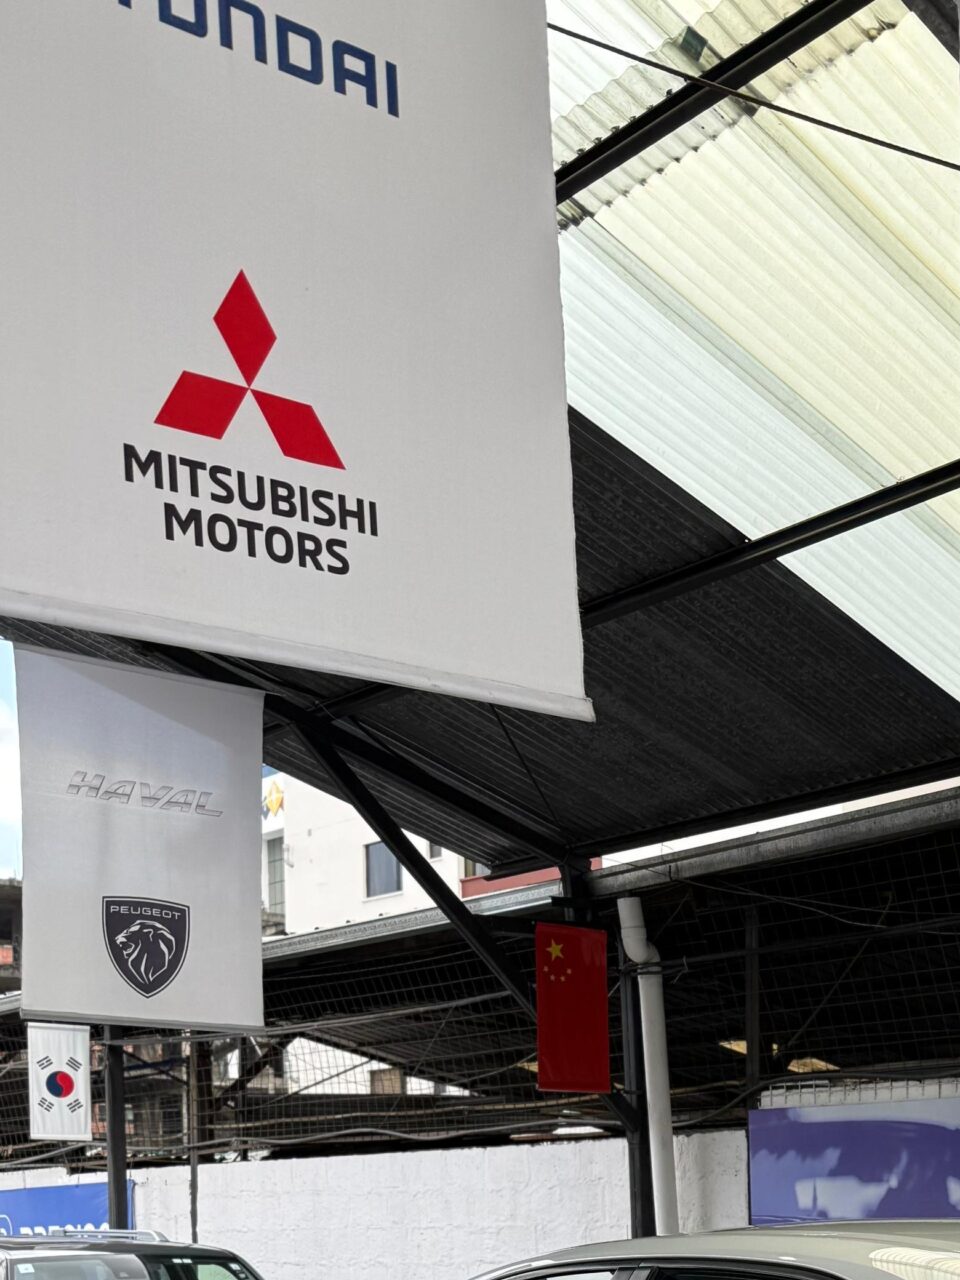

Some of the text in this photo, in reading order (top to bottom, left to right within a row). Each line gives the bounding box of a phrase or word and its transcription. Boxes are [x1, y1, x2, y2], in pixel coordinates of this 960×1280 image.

[117, 0, 400, 119] UNDAI
[122, 442, 379, 537] MITSUBISHI
[163, 501, 351, 576] MOTORS
[65, 769, 225, 818] HAVAL
[110, 904, 182, 920] PEUGEOT
